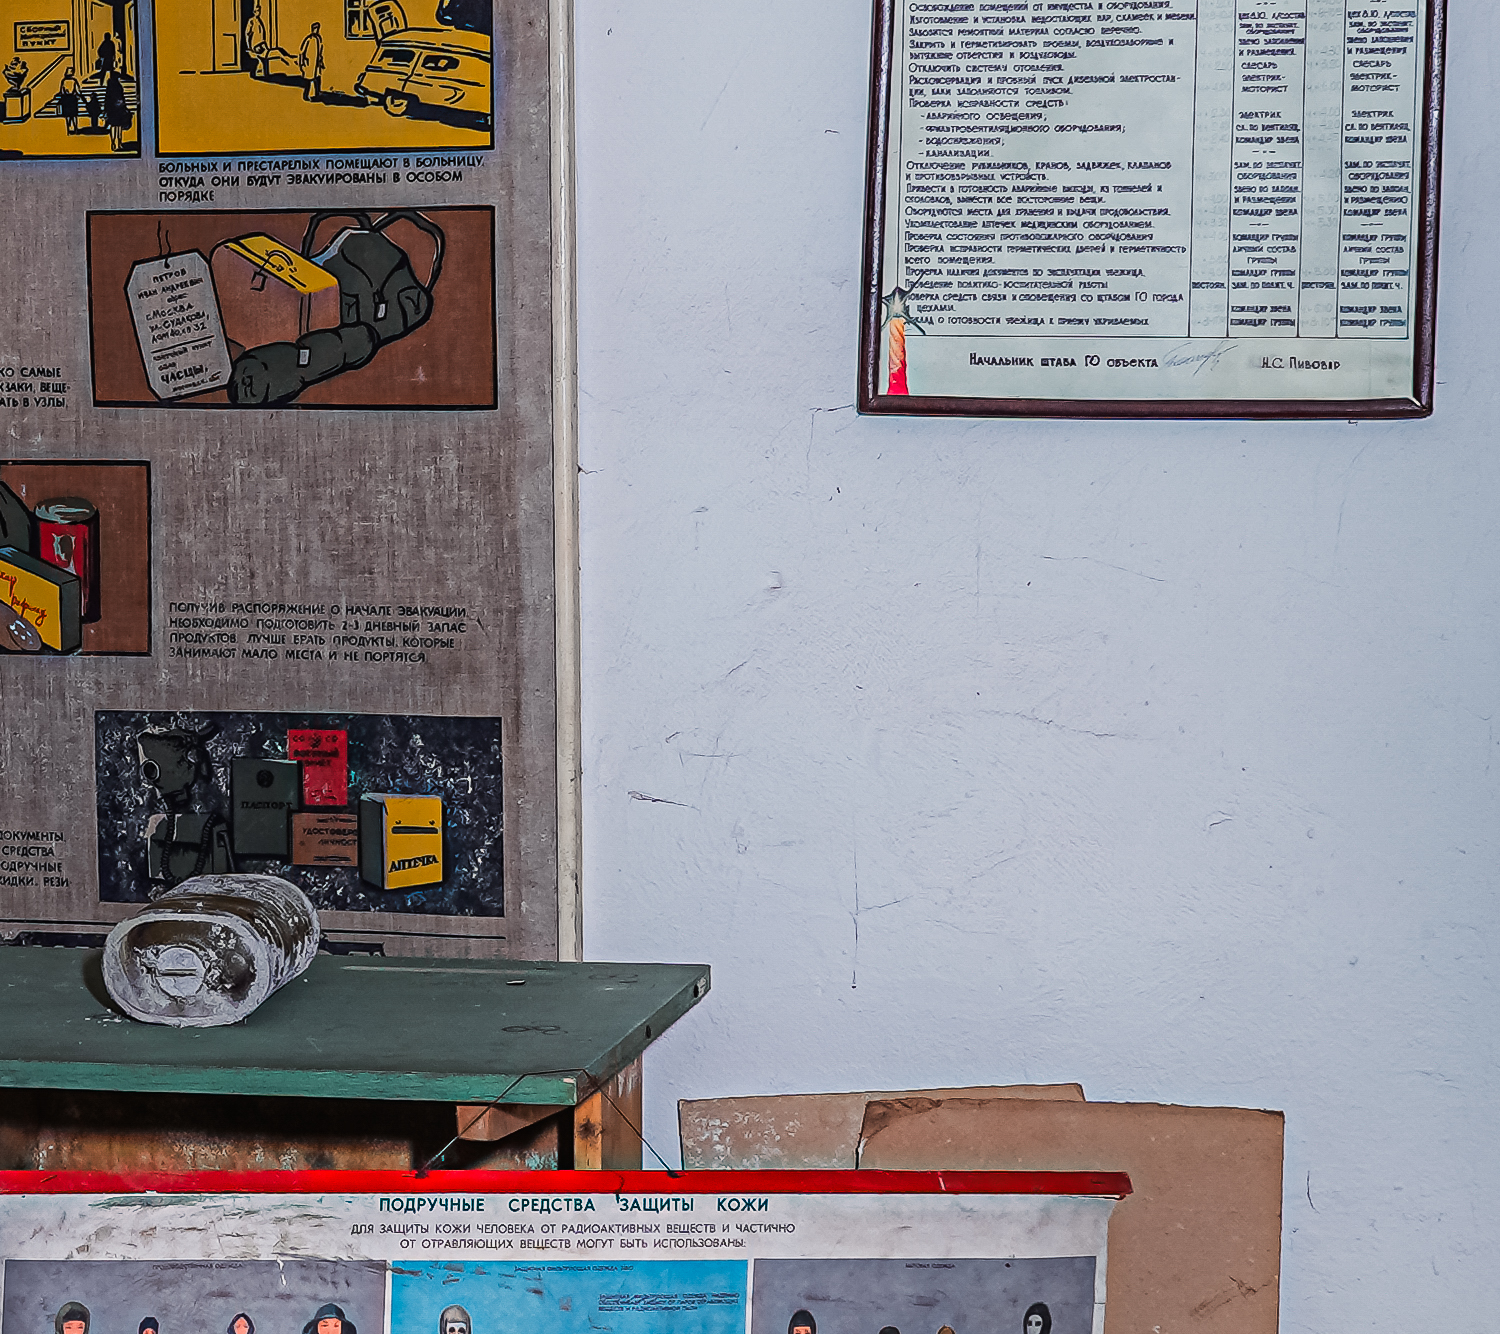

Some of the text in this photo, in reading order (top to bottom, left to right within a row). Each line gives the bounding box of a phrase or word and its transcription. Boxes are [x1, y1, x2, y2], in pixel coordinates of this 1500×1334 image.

[160, 162, 218, 173] БОЛЬНЫХ
[223, 162, 231, 172] И
[238, 159, 320, 172] ПРЕСТАРЕЛЫХ
[326, 158, 398, 170] ПОМЕЩАЮТ
[403, 158, 410, 167] В
[159, 171, 462, 187] ОТКУДА ОНИ БУДУТ ЭВАКУИРОВАНЫ В ОСОБОМ
[160, 190, 215, 202] ПОРЯДКЕ
[1085, 355, 1100, 367] ГО
[380, 1198, 769, 1215] ПОДРУЧНЫЕ СРЕДСТВА ЗАЩИТЫ КОЖИ
[350, 1223, 795, 1236] ДЛЯ ЗАЩИТЫ КОЖИ ЧЕЛОВЕКА ОТ РАДИОАКТИВНЫХ ВЕЩЕСТВ И ЧАСТИЧНО
[400, 1239, 416, 1249] ОТ
[422, 1238, 513, 1250] ОТРАВЛЯЮЩИХ
[520, 1238, 570, 1250] ВЕЩЕСТВ
[576, 1238, 614, 1249] МОГУТ
[620, 1238, 648, 1249] БЫТЬ
